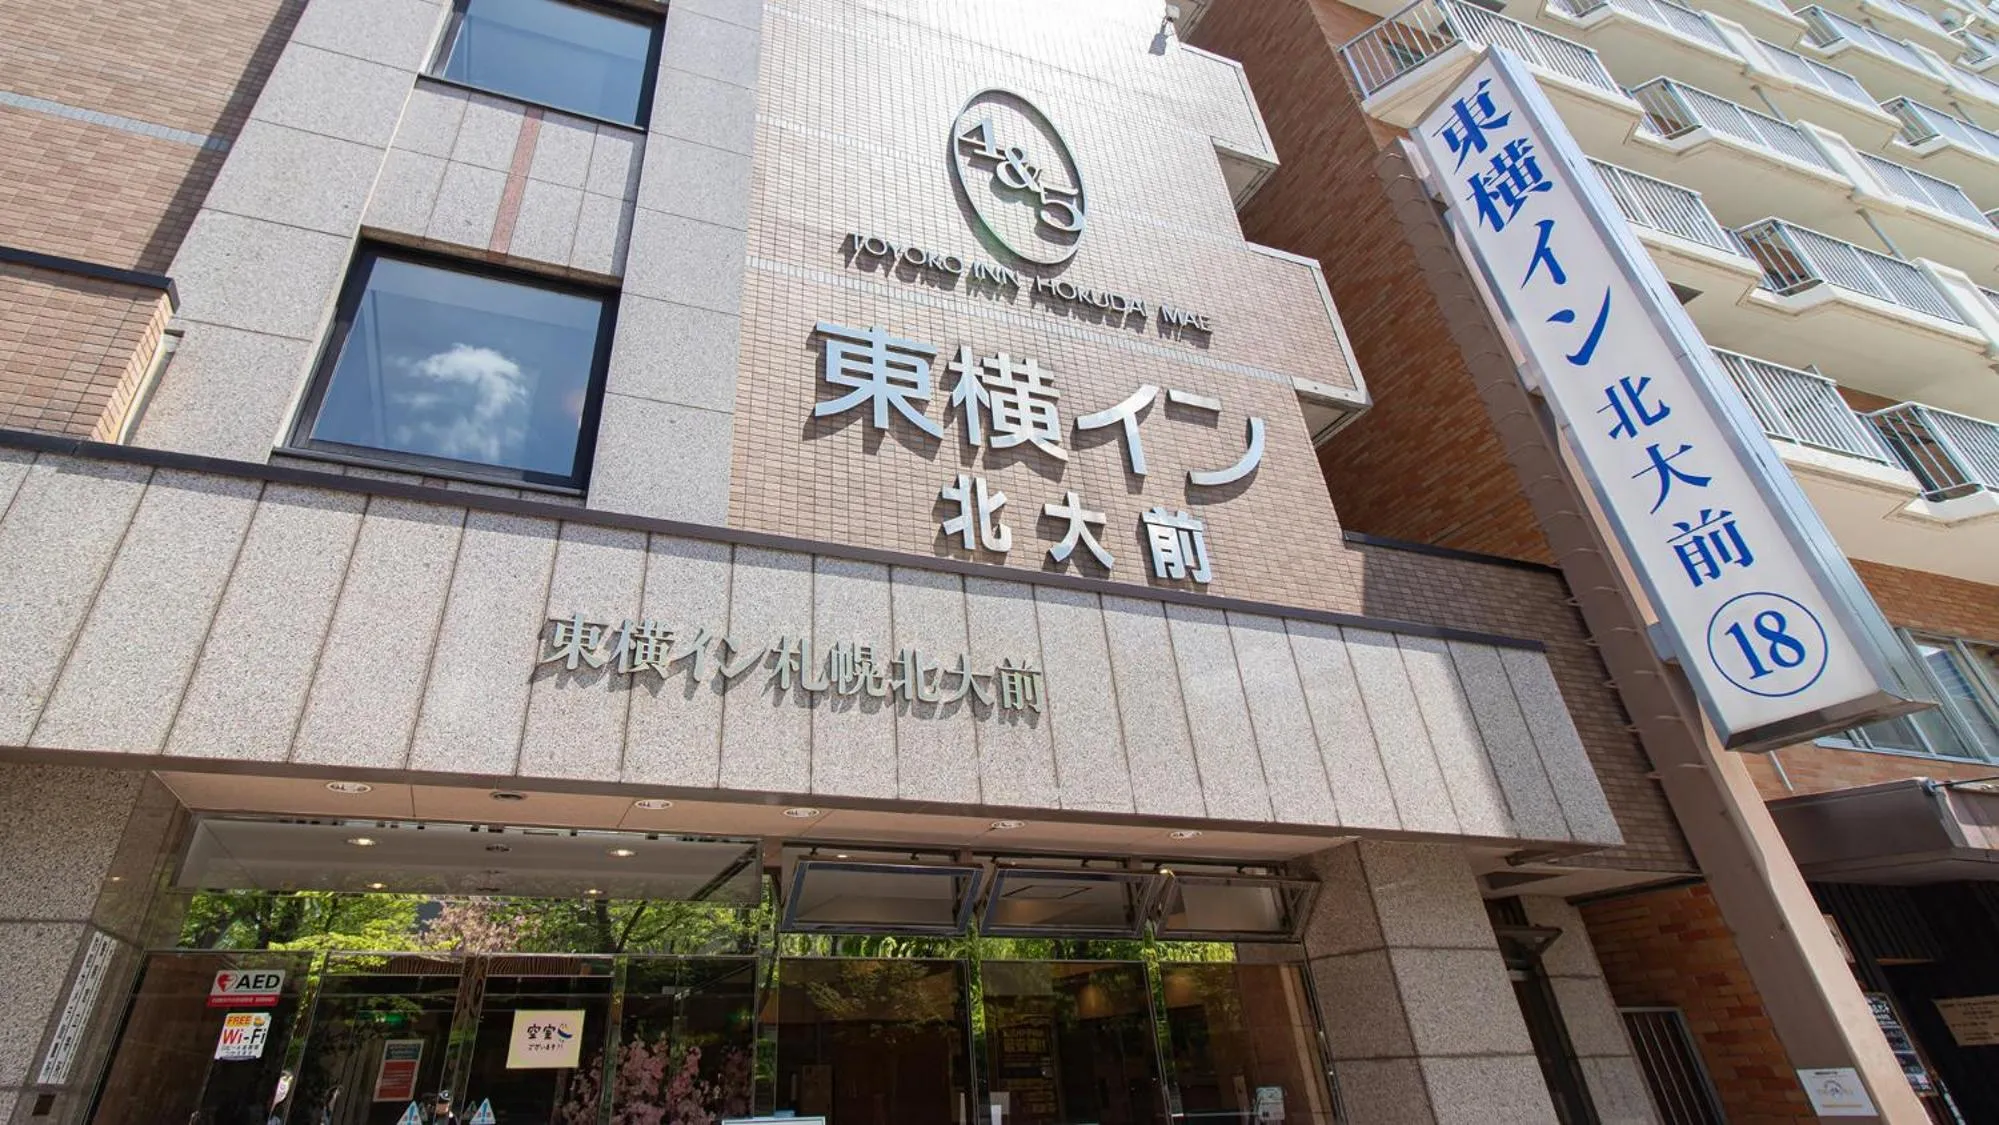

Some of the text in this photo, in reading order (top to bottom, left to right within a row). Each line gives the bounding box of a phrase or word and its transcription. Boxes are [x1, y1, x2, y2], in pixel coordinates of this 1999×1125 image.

[849, 232, 1212, 333] TOYOKO INN HOKUDAI MAE
[814, 320, 1265, 487] 東横イン
[942, 474, 1212, 584] 北大前
[543, 612, 1043, 713] 東横イン札幌北大前
[235, 973, 280, 990] AED
[223, 1028, 267, 1045] Wi-Fi
[226, 1015, 253, 1026] FREE
[527, 1023, 556, 1040] 空室
